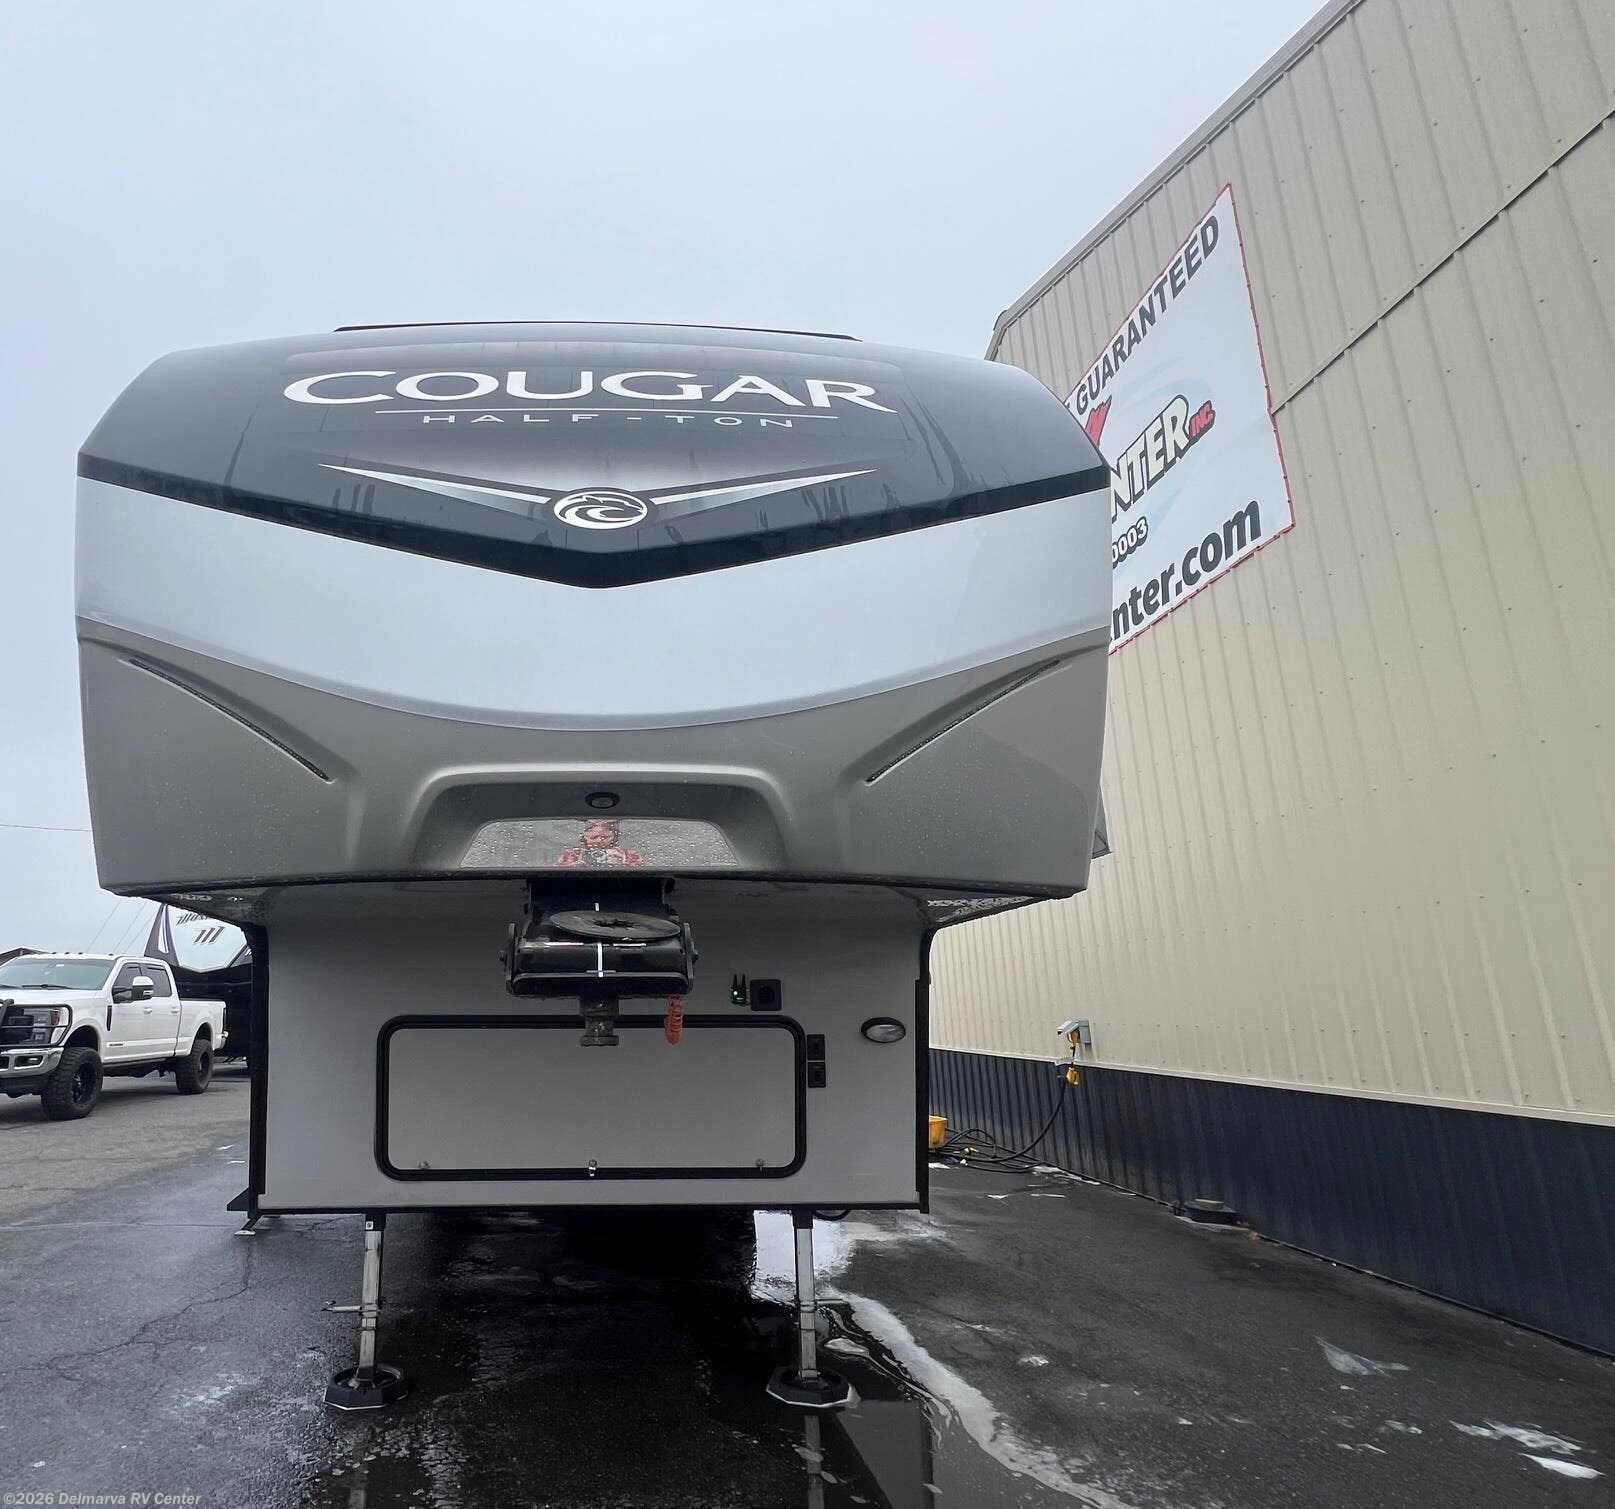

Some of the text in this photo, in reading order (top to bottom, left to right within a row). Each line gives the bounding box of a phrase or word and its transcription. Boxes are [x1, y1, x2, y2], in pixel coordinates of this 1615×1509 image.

[1077, 215, 1219, 416] GUARANTEED
[283, 370, 899, 414] COUGAR
[422, 413, 794, 428] HALF-TON
[1113, 500, 1262, 641] nter.com
